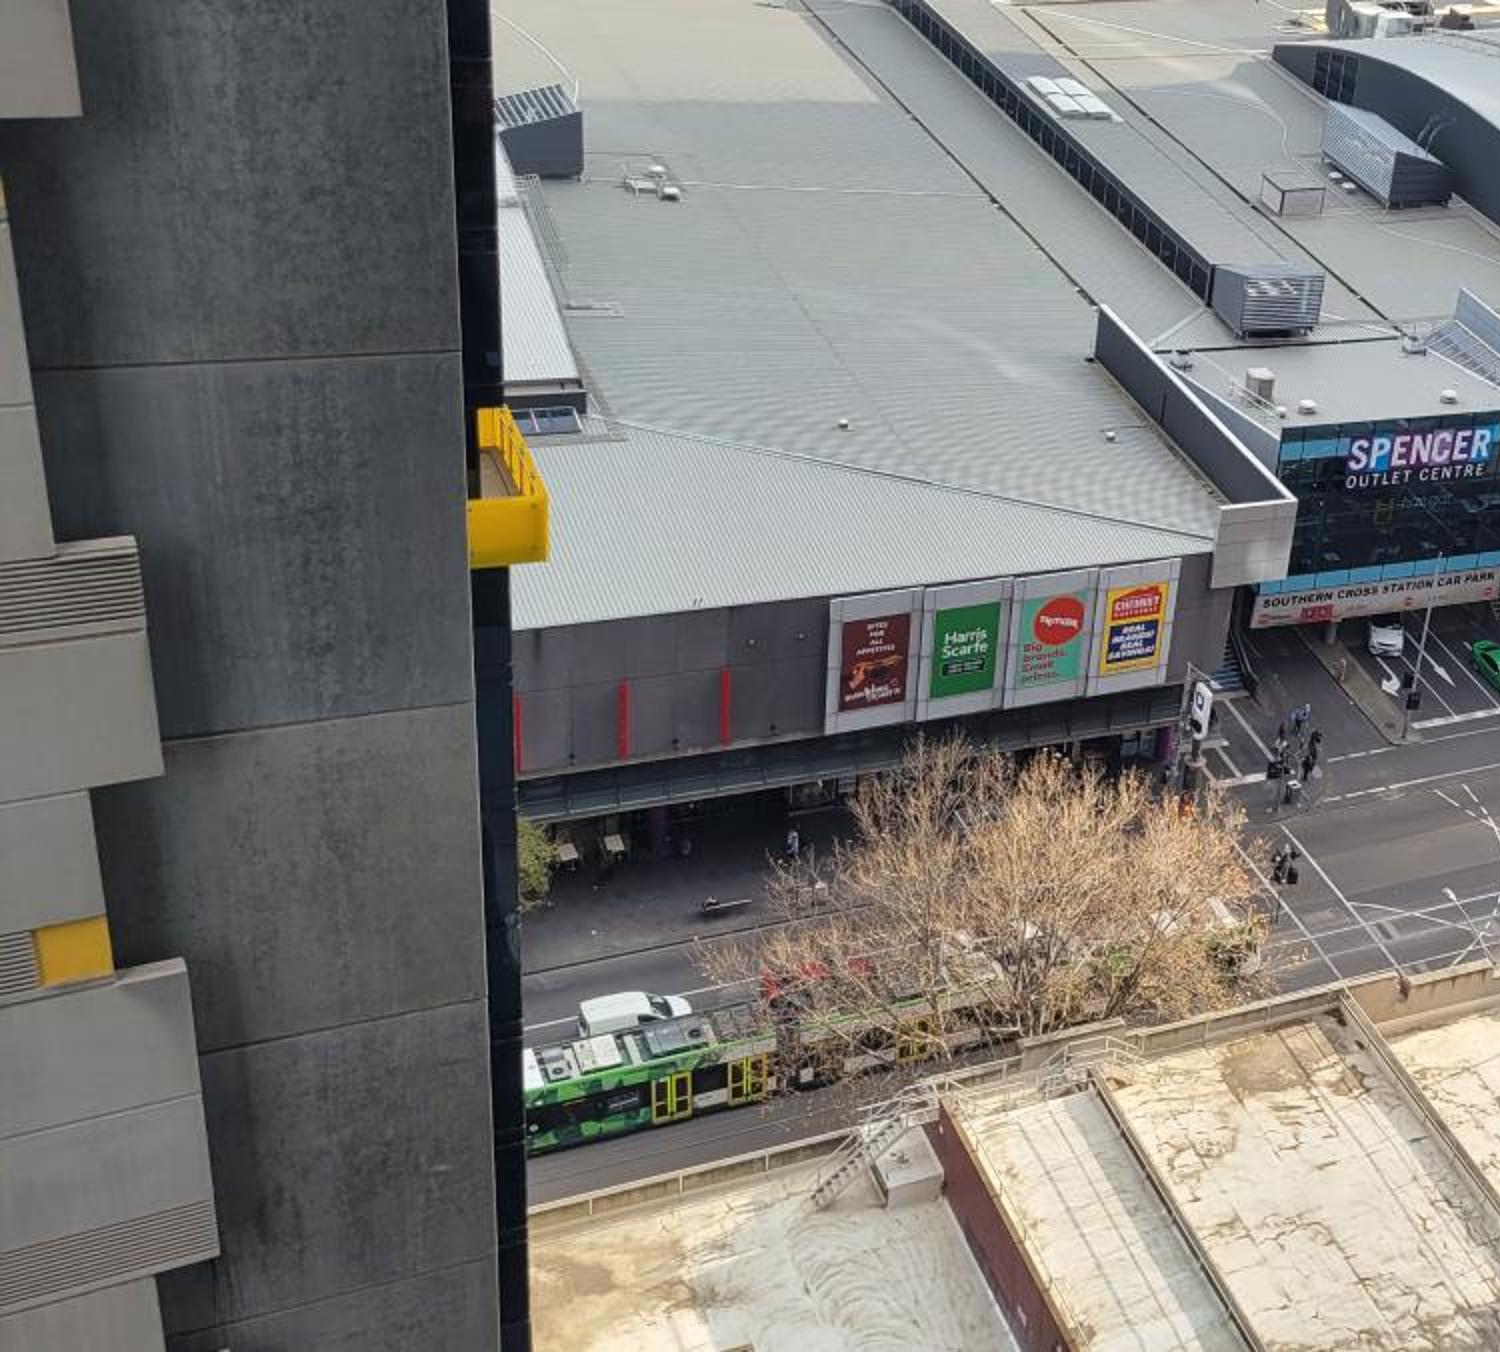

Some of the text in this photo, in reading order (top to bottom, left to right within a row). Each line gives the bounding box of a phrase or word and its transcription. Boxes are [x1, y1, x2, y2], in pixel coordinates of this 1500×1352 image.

[1348, 429, 1491, 470] SPENCER
[1345, 463, 1485, 489] OUTLET CENTRE
[1262, 570, 1496, 608] SOUTHERN CROSS STATION CAR PARK
[944, 627, 989, 646] Harris
[942, 641, 990, 659] Scarfe
